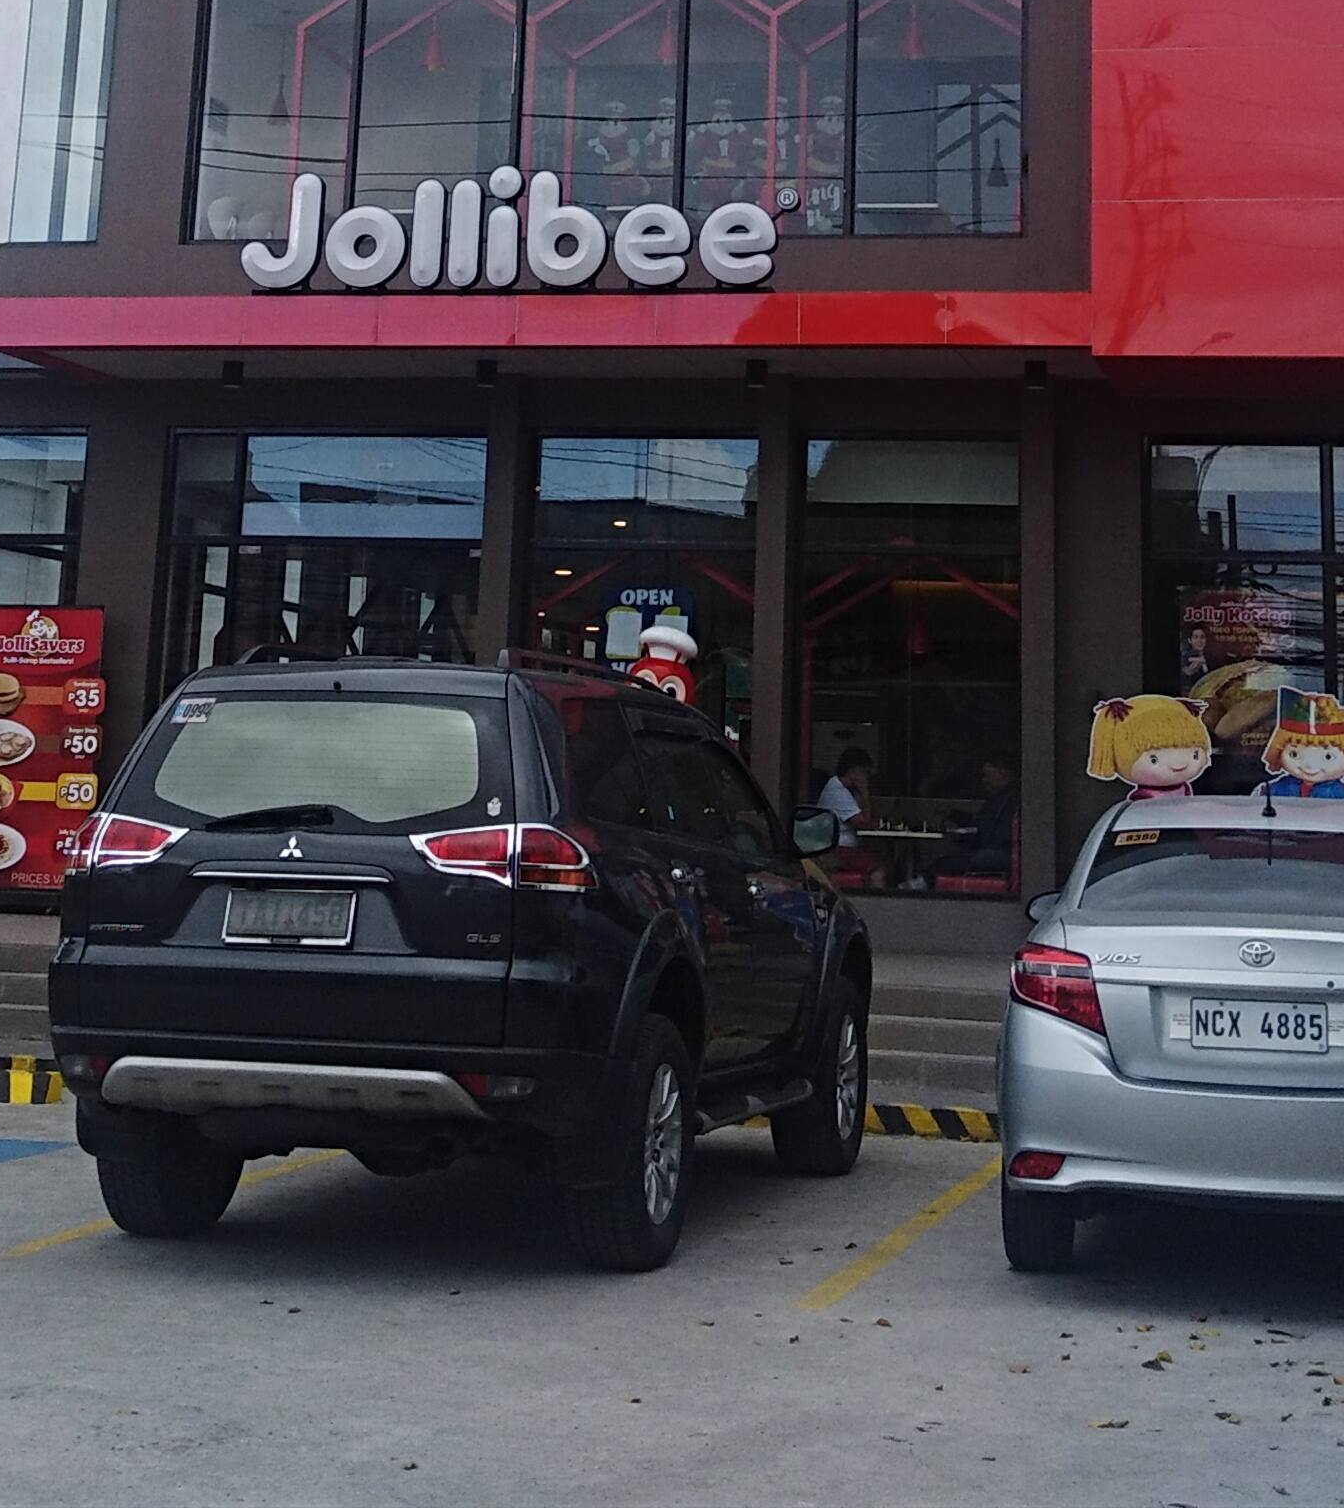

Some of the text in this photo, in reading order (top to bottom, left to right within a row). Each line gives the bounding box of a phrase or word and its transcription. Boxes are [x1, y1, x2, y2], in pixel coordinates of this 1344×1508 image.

[240, 165, 778, 290] Jollibee
[620, 588, 674, 606] OPEN
[1184, 606, 1226, 625] Jolly
[11, 872, 51, 885] PRICES
[1095, 953, 1141, 964] VIOS
[1195, 1009, 1241, 1038] NCX
[1260, 1012, 1323, 1041] 4885
